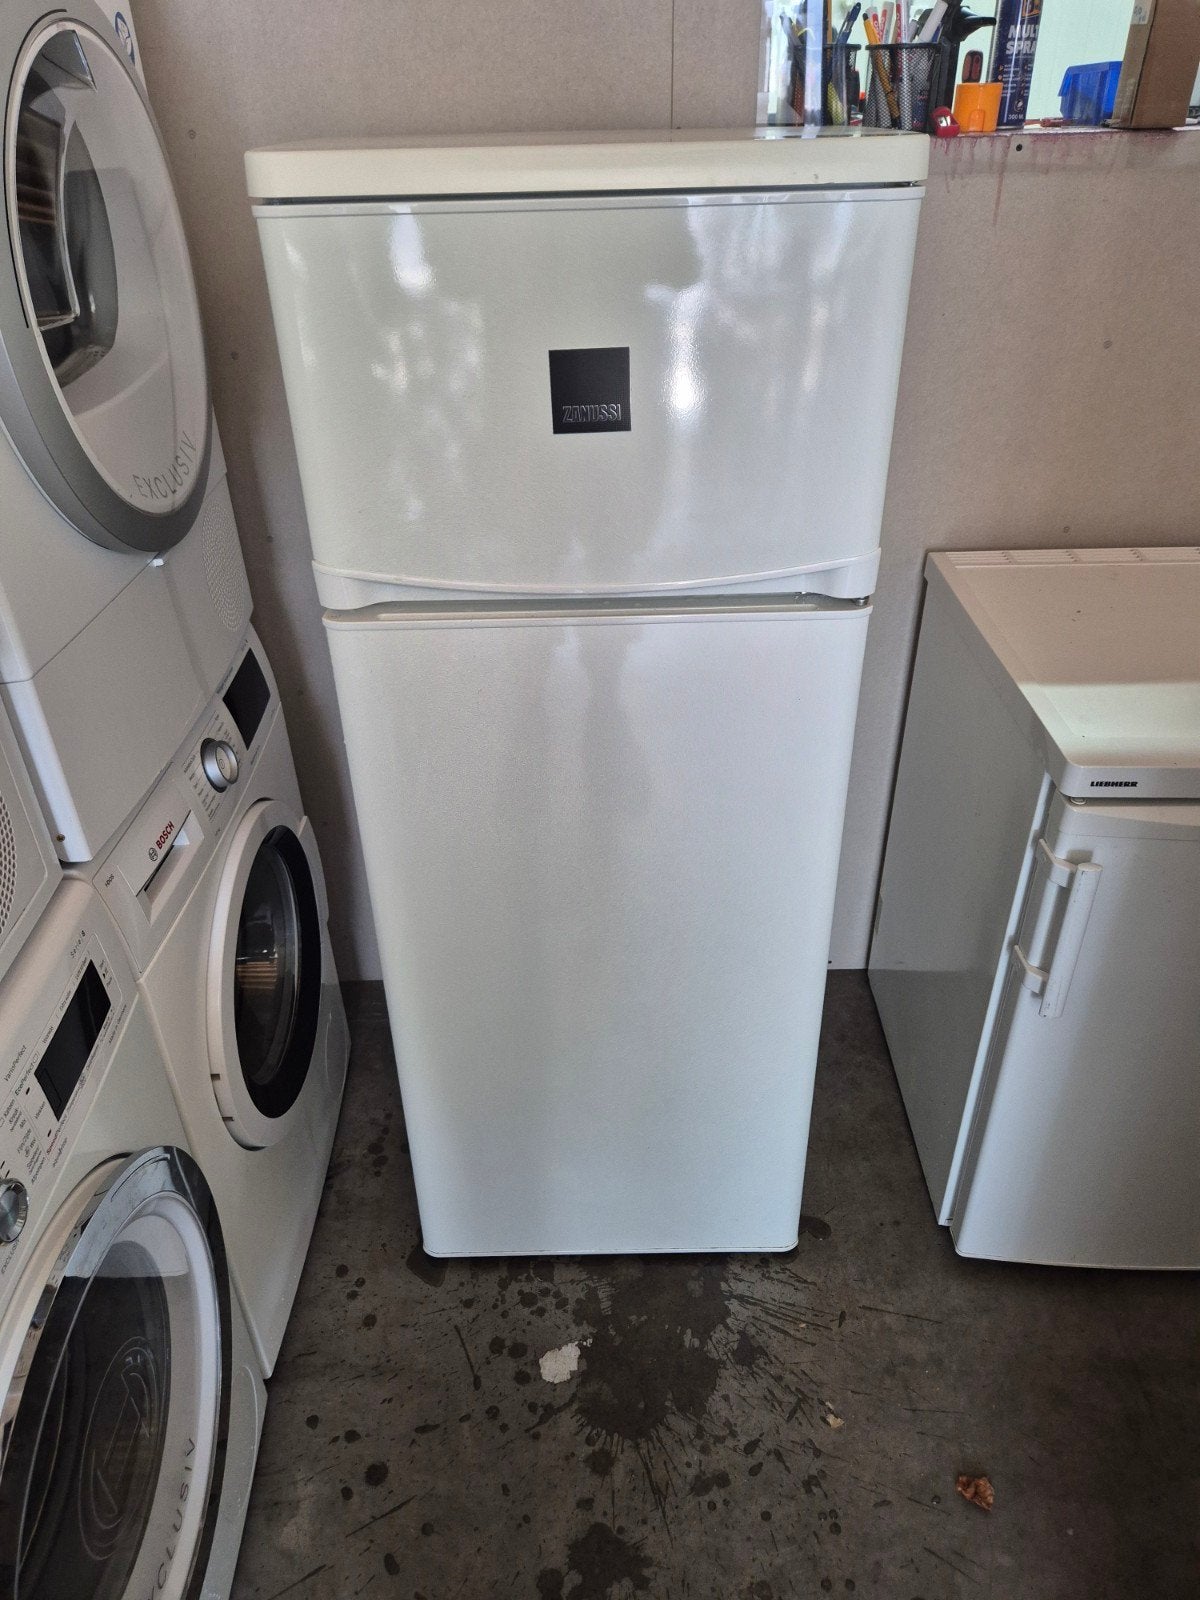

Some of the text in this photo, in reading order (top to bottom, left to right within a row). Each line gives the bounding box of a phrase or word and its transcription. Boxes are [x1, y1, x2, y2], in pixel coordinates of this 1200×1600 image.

[562, 403, 622, 423] ZANUSSI
[132, 430, 197, 499] EXCLUSIV
[1089, 780, 1139, 788] LIEBHERR
[155, 821, 175, 850] BOSCH
[14, 1062, 34, 1096] EcoPerfect
[148, 1437, 196, 1600] CLUSIV
